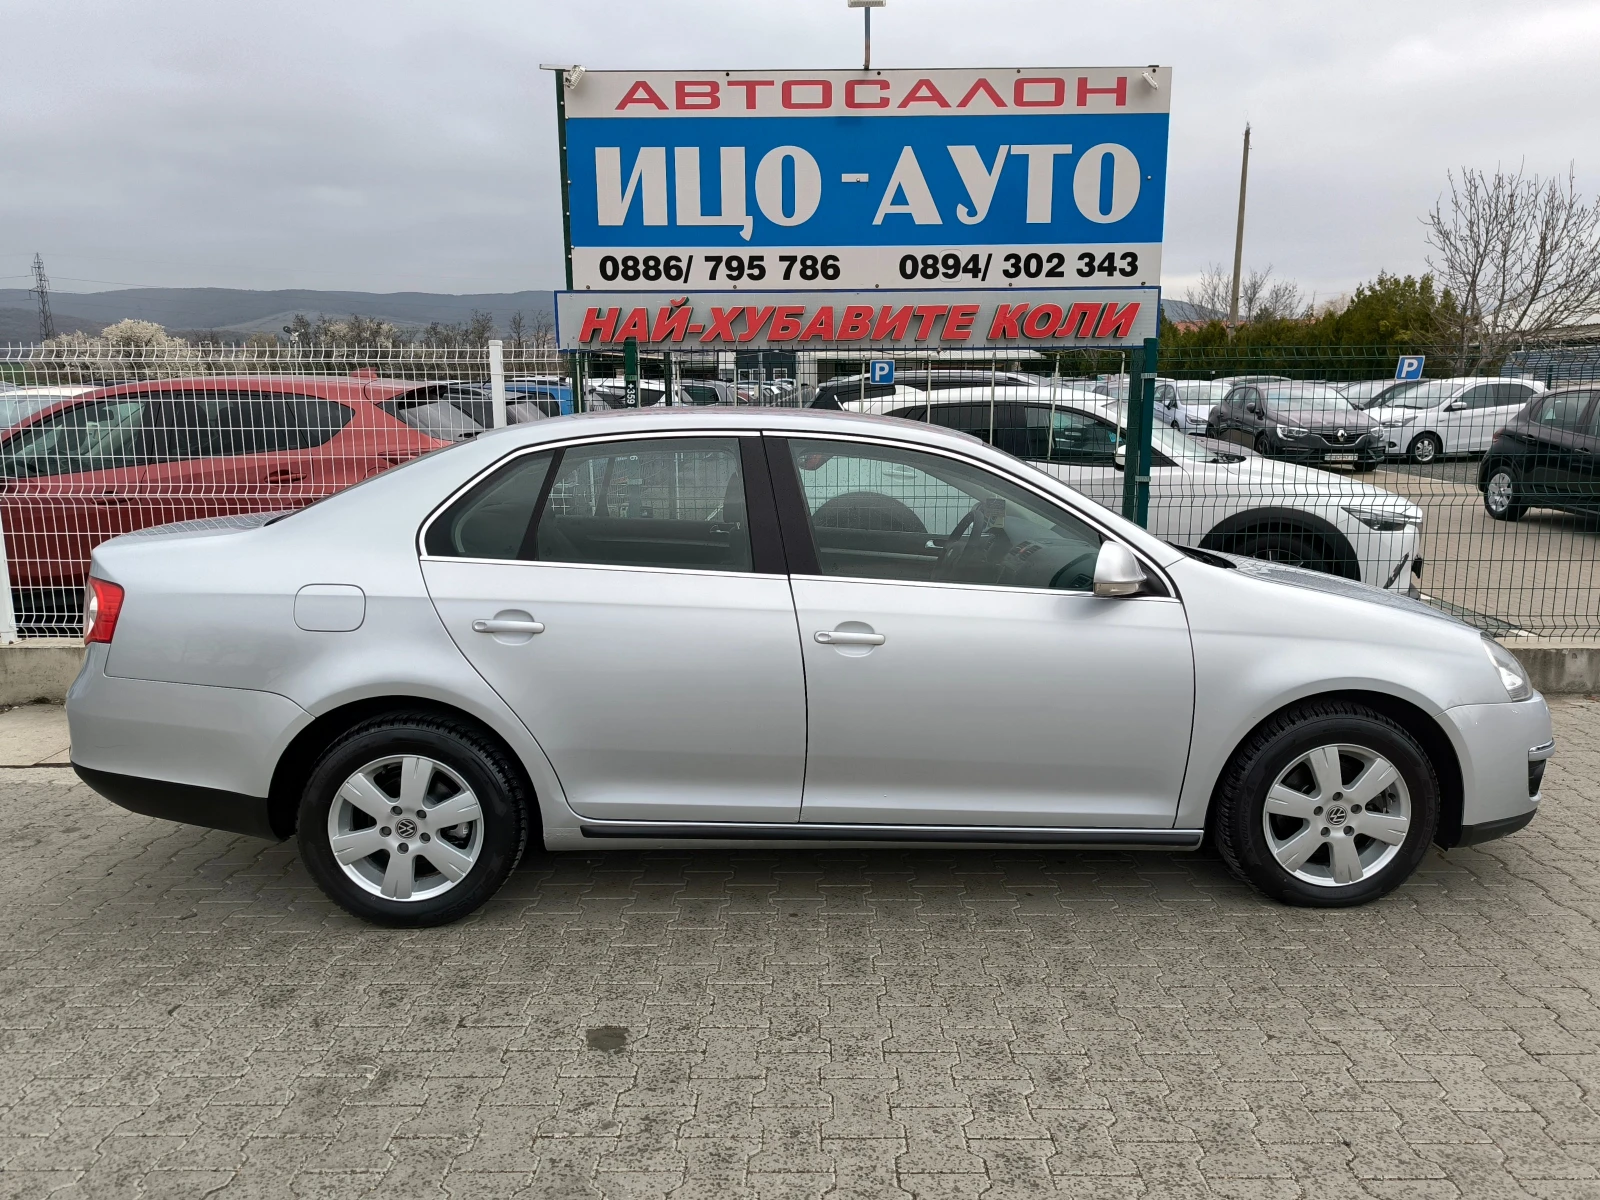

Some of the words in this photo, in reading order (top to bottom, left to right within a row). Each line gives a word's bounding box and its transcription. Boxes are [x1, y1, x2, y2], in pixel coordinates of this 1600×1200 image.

[614, 77, 1128, 110] АВТОСАЛОН
[599, 255, 693, 283] 0886/
[704, 255, 767, 281] 795
[778, 254, 841, 281] 786
[899, 253, 993, 281] 0894/
[1002, 252, 1066, 279] 302
[1075, 252, 1139, 278] 343
[578, 296, 980, 343] НАЙ-ХУБАВИТЕ
[987, 302, 1142, 341] КОЛИ
[875, 363, 889, 381] P
[1401, 359, 1418, 377] P
[627, 383, 636, 404] +359
